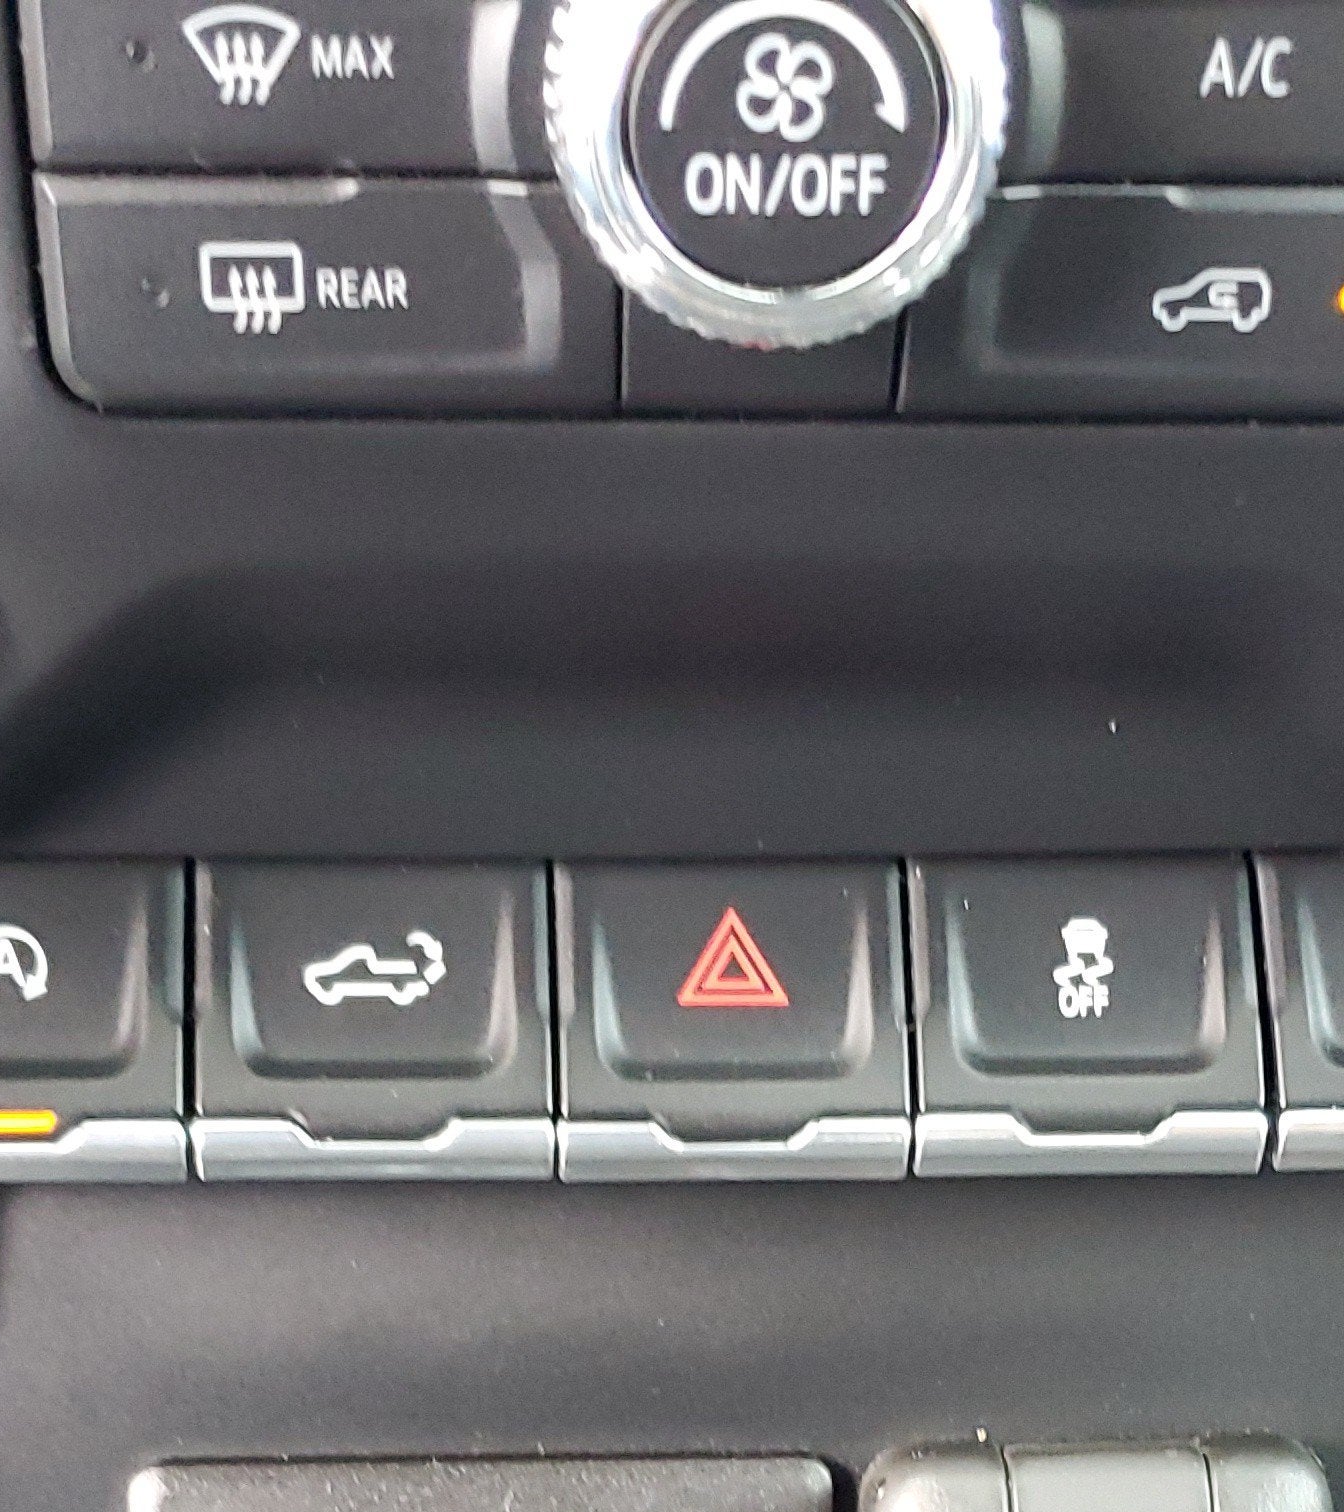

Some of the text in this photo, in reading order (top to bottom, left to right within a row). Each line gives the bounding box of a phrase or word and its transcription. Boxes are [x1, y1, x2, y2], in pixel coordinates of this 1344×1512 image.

[309, 34, 396, 81] MAX
[1199, 36, 1293, 99] A/C
[684, 152, 889, 218] ON/OFF
[315, 266, 409, 311] REAR
[1058, 984, 1110, 1019] OFF
